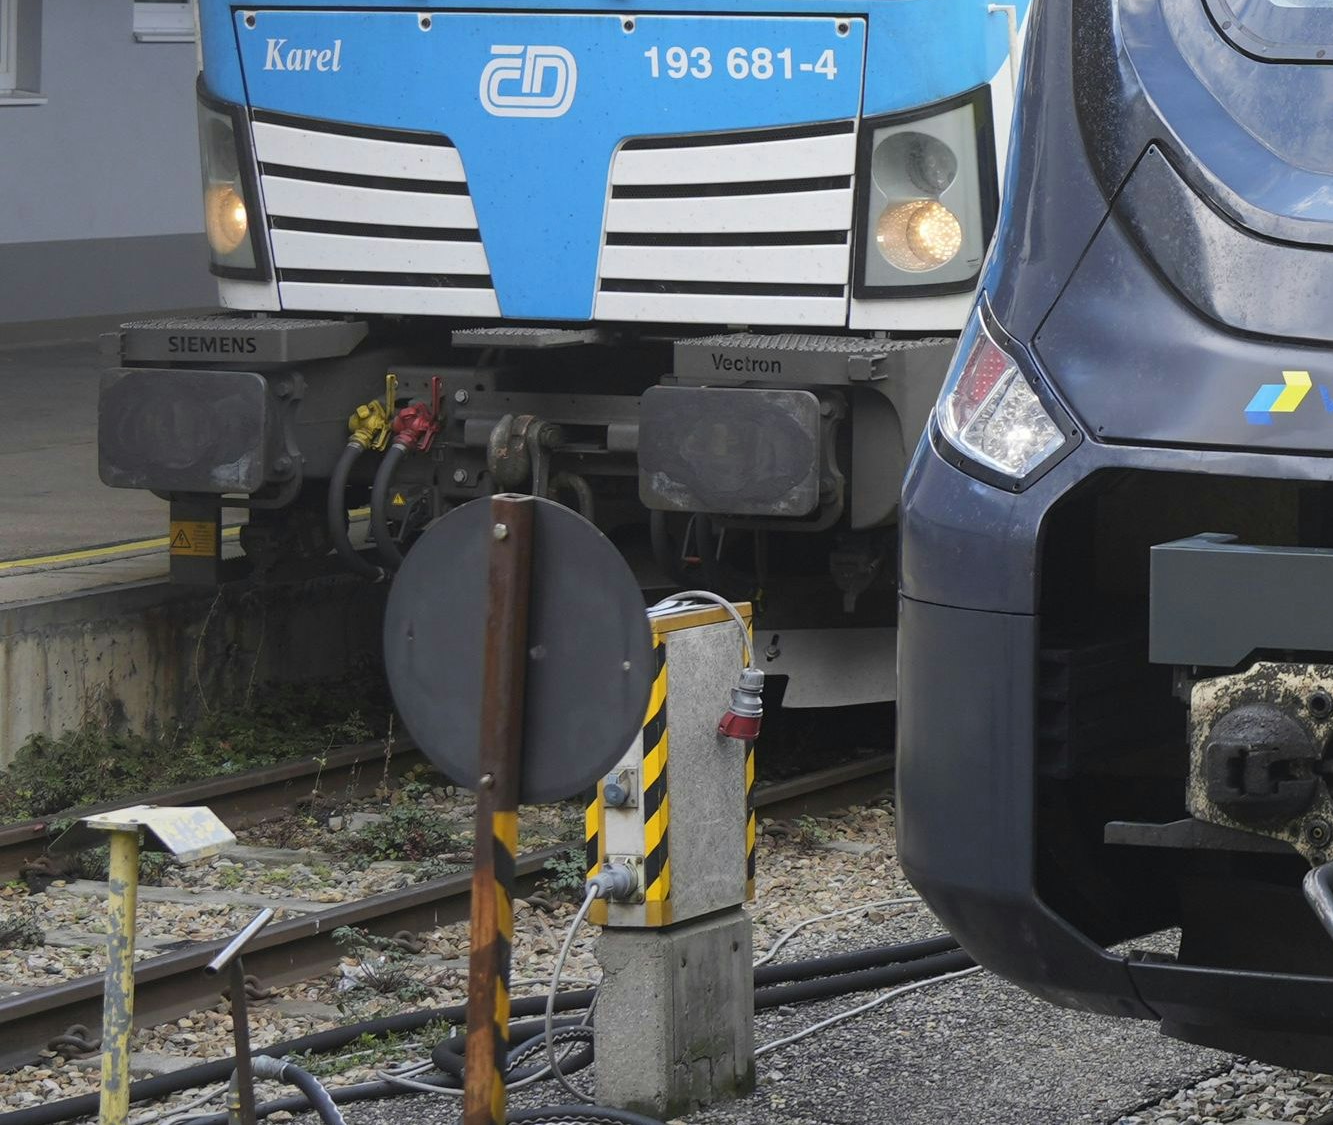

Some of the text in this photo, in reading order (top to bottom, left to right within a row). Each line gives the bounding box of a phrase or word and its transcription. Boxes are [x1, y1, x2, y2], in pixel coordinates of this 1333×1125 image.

[263, 38, 342, 73] Karel
[644, 46, 838, 80] 193 681-4
[168, 335, 257, 353] SIEMENS
[711, 353, 782, 374] Vectron
